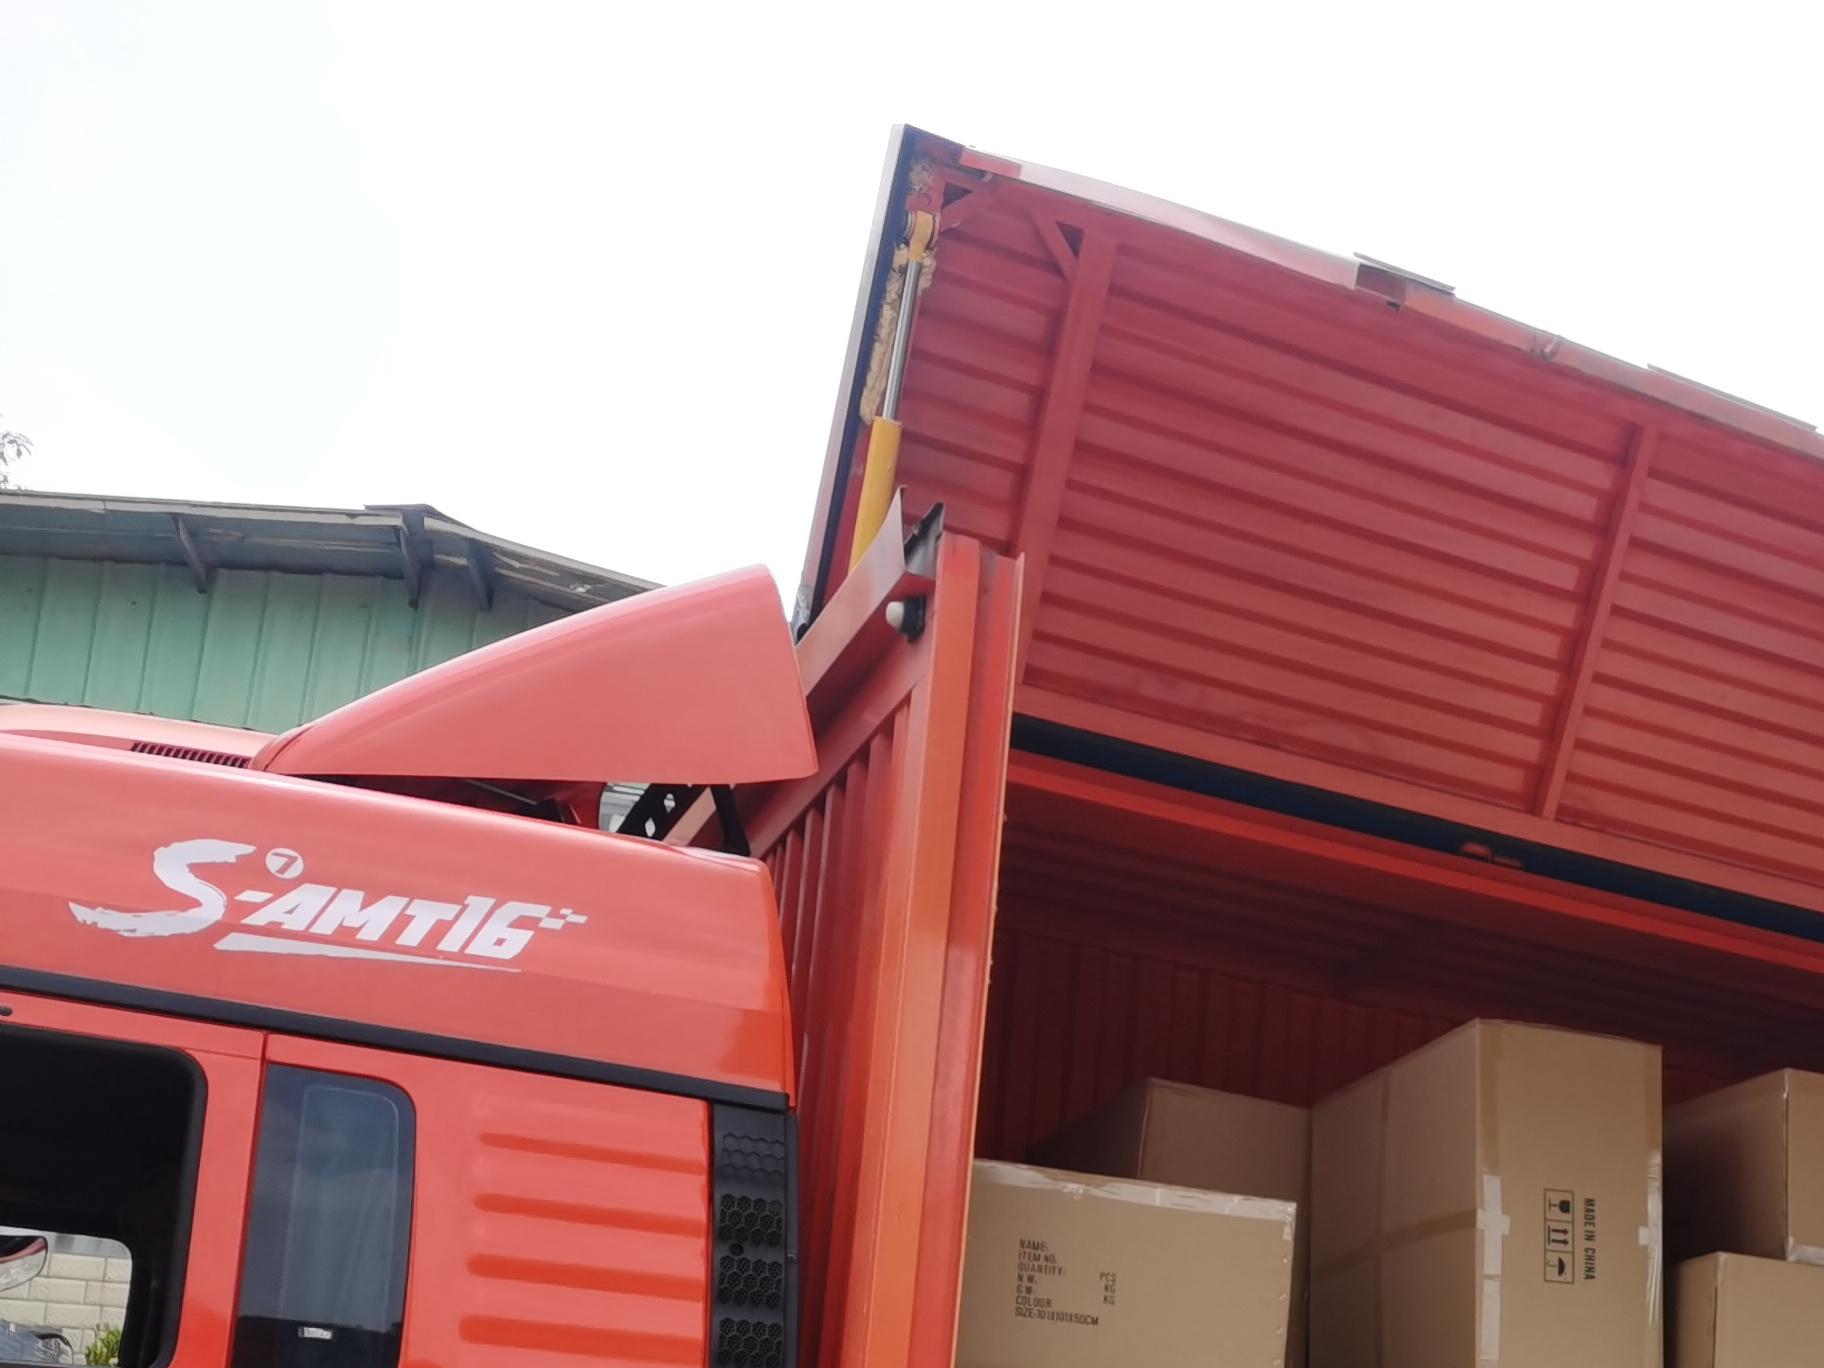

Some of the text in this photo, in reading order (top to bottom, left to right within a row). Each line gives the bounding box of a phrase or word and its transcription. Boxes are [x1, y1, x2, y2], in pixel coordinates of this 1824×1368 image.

[1583, 1197, 1596, 1280] MADE IN CHINA
[1018, 1249, 1041, 1262] ITEM
[1099, 1272, 1117, 1283] PCS
[1104, 1283, 1116, 1294] KG
[1103, 1295, 1115, 1305] KG
